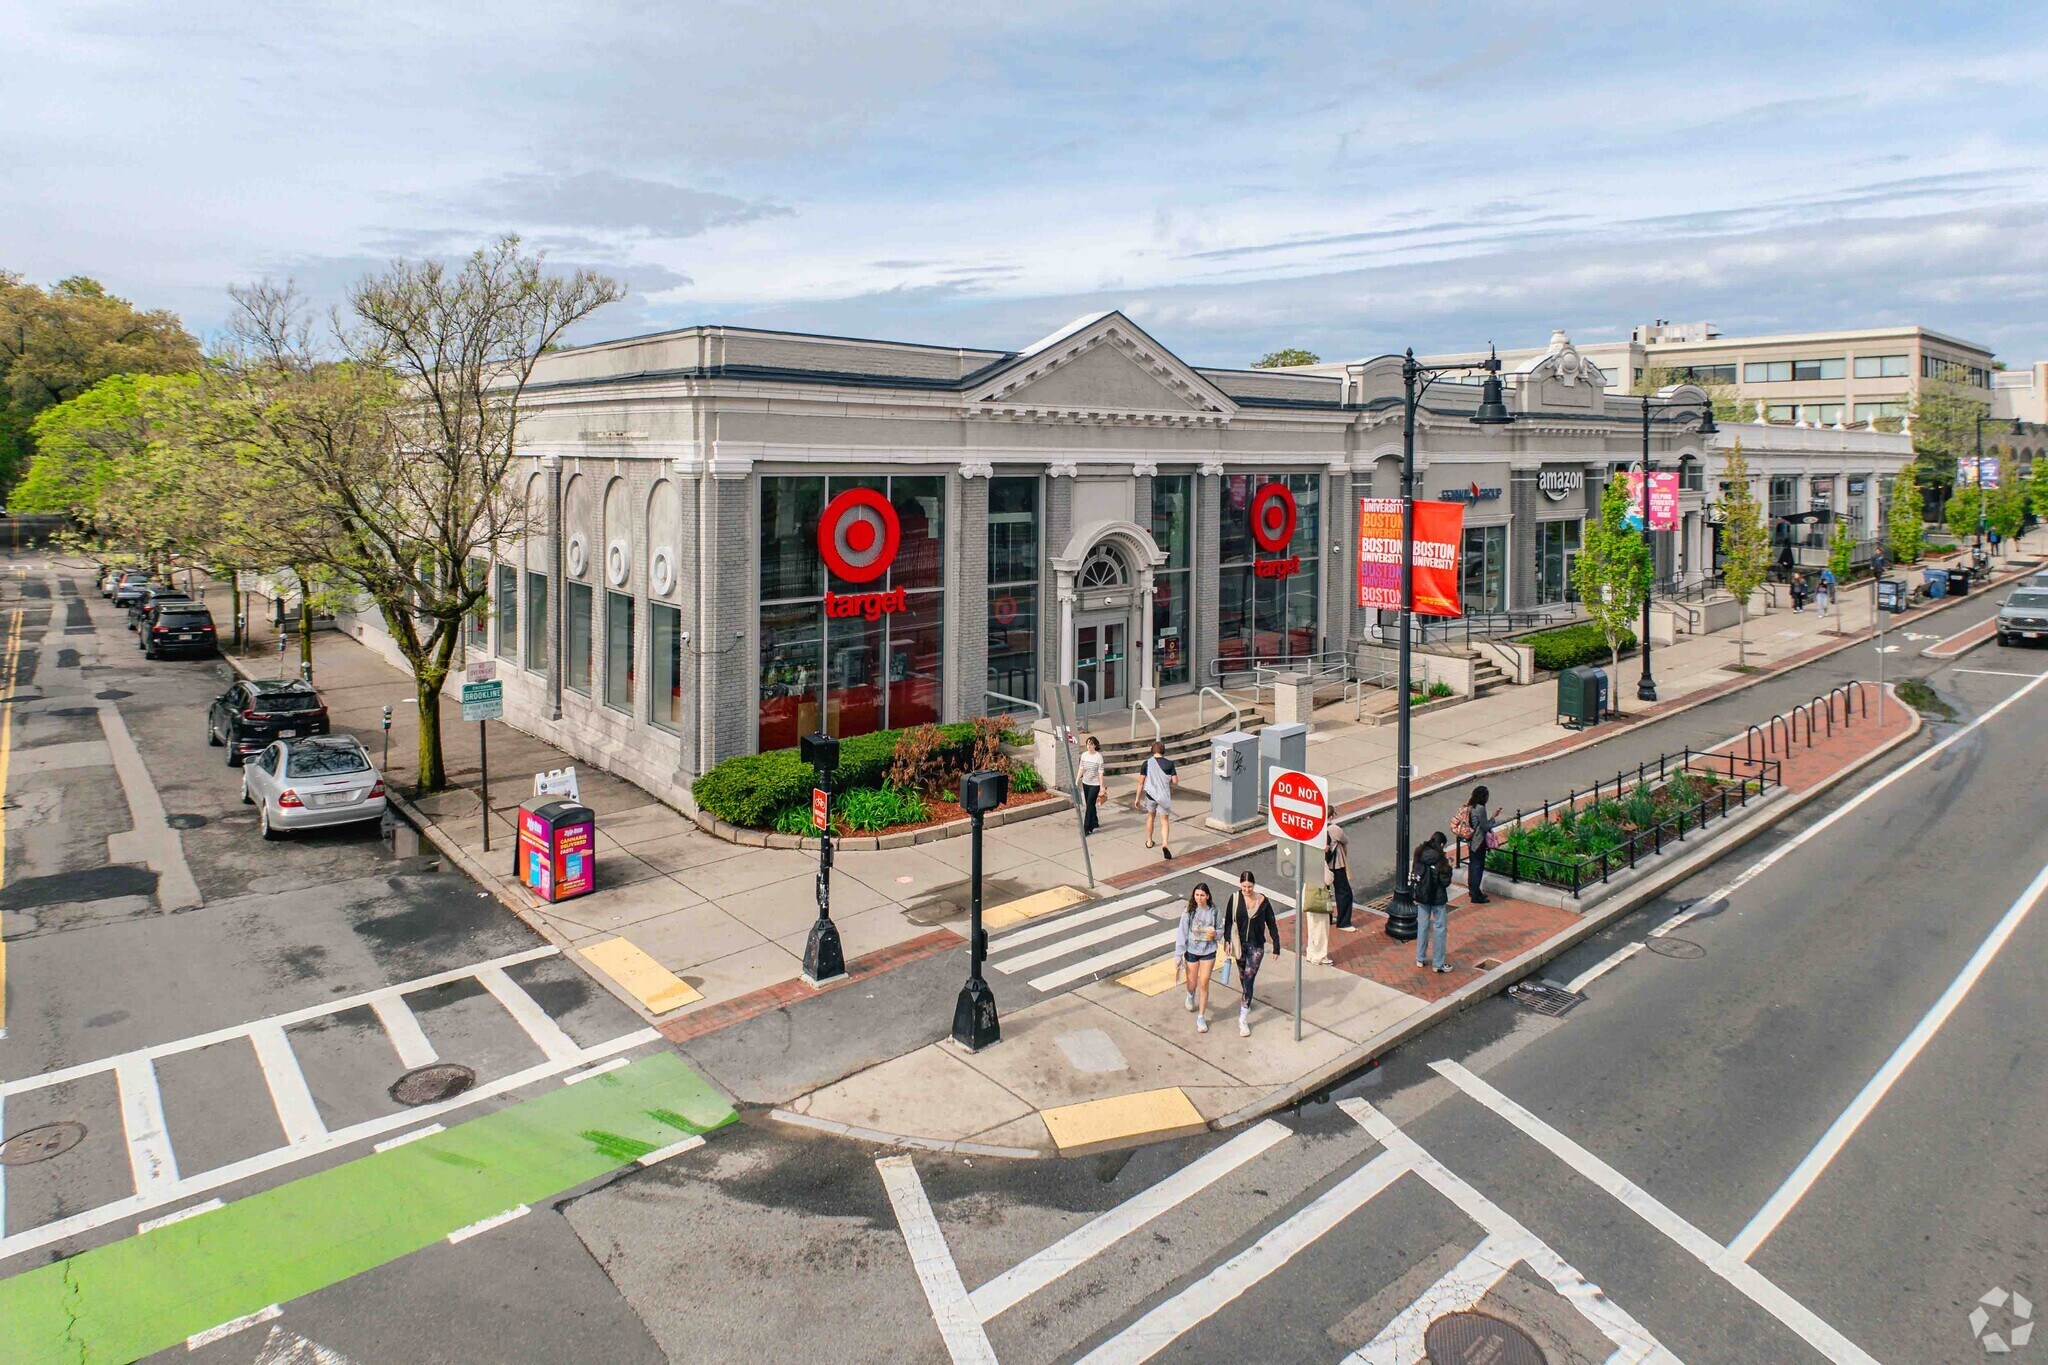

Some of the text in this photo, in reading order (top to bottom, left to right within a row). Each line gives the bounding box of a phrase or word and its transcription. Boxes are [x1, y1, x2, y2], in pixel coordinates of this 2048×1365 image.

[1539, 471, 1583, 490] amazon
[1364, 502, 1404, 514] UNIVERSITY
[1363, 512, 1403, 529] BOSTON
[1362, 527, 1403, 539] UNIVERSITY
[1362, 537, 1403, 554] BOSTON
[1413, 541, 1455, 560] BOSTON
[1362, 552, 1403, 564] UNIVERSITY
[1413, 556, 1454, 570] UNIVERSITY
[1254, 554, 1301, 580] target
[1362, 562, 1402, 579] BOSTON
[824, 585, 907, 622] target
[1361, 586, 1402, 604] BOSTON
[465, 690, 500, 700] BROOKLINE
[1278, 781, 1318, 802] DO NOT
[1281, 812, 1314, 831] ENTER
[560, 834, 587, 844] CANNABIS
[560, 840, 586, 849] DELIVERED
